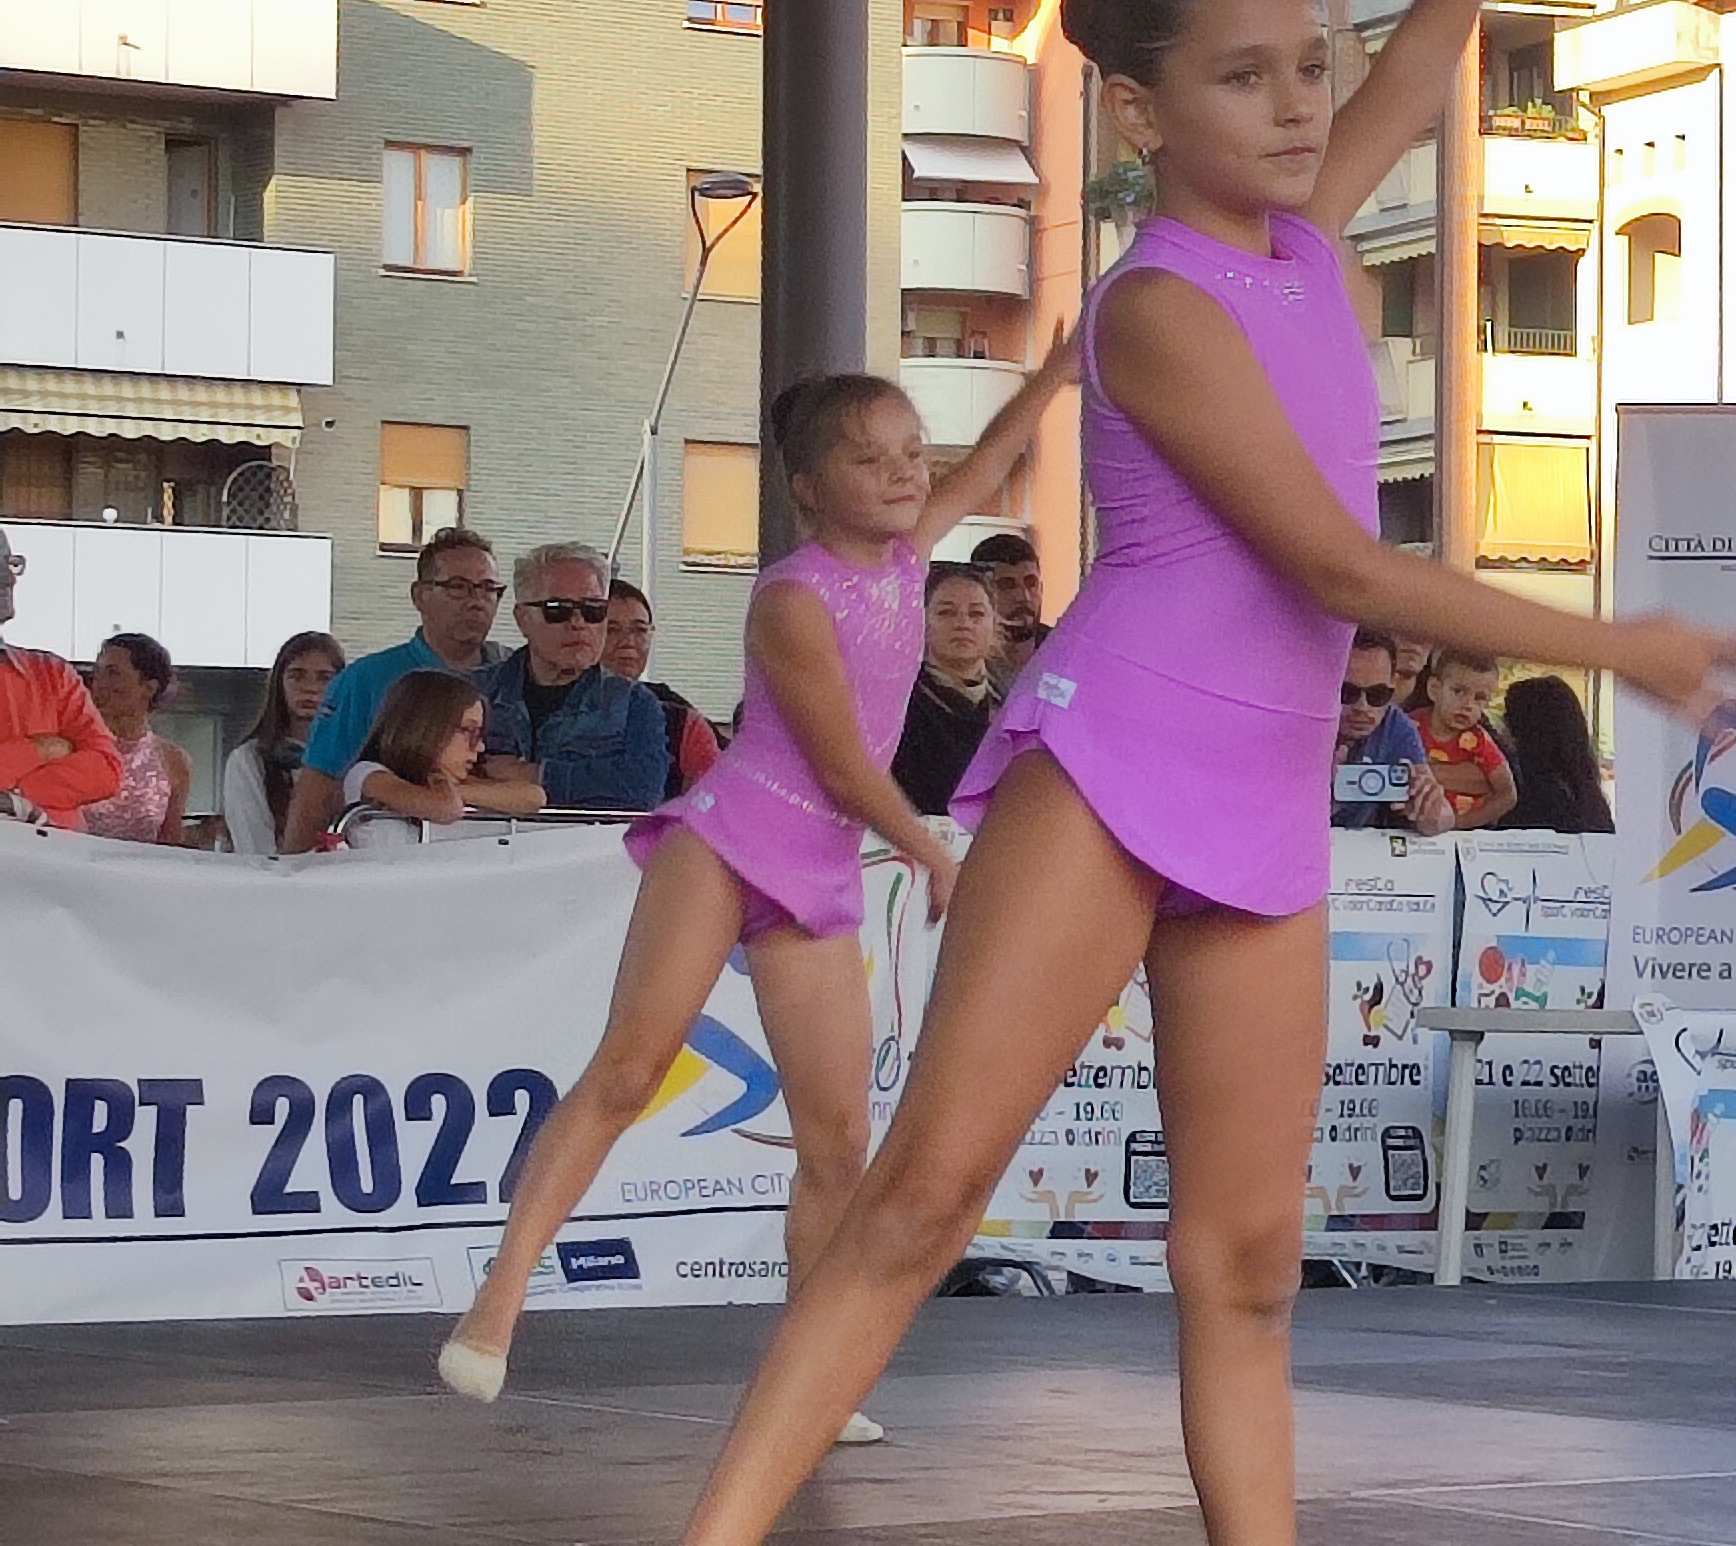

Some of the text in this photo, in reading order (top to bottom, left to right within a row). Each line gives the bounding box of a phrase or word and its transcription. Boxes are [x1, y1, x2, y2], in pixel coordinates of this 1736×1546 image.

[1632, 925, 1734, 946] EUROPEAN
[1632, 955, 1712, 982] Vivere
[1718, 961, 1732, 981] a
[1323, 1057, 1422, 1086] settembre
[1475, 1058, 1597, 1088] 21 e 22 sette
[248, 1068, 562, 1216] 2022
[621, 1178, 744, 1203] EUROPEAN
